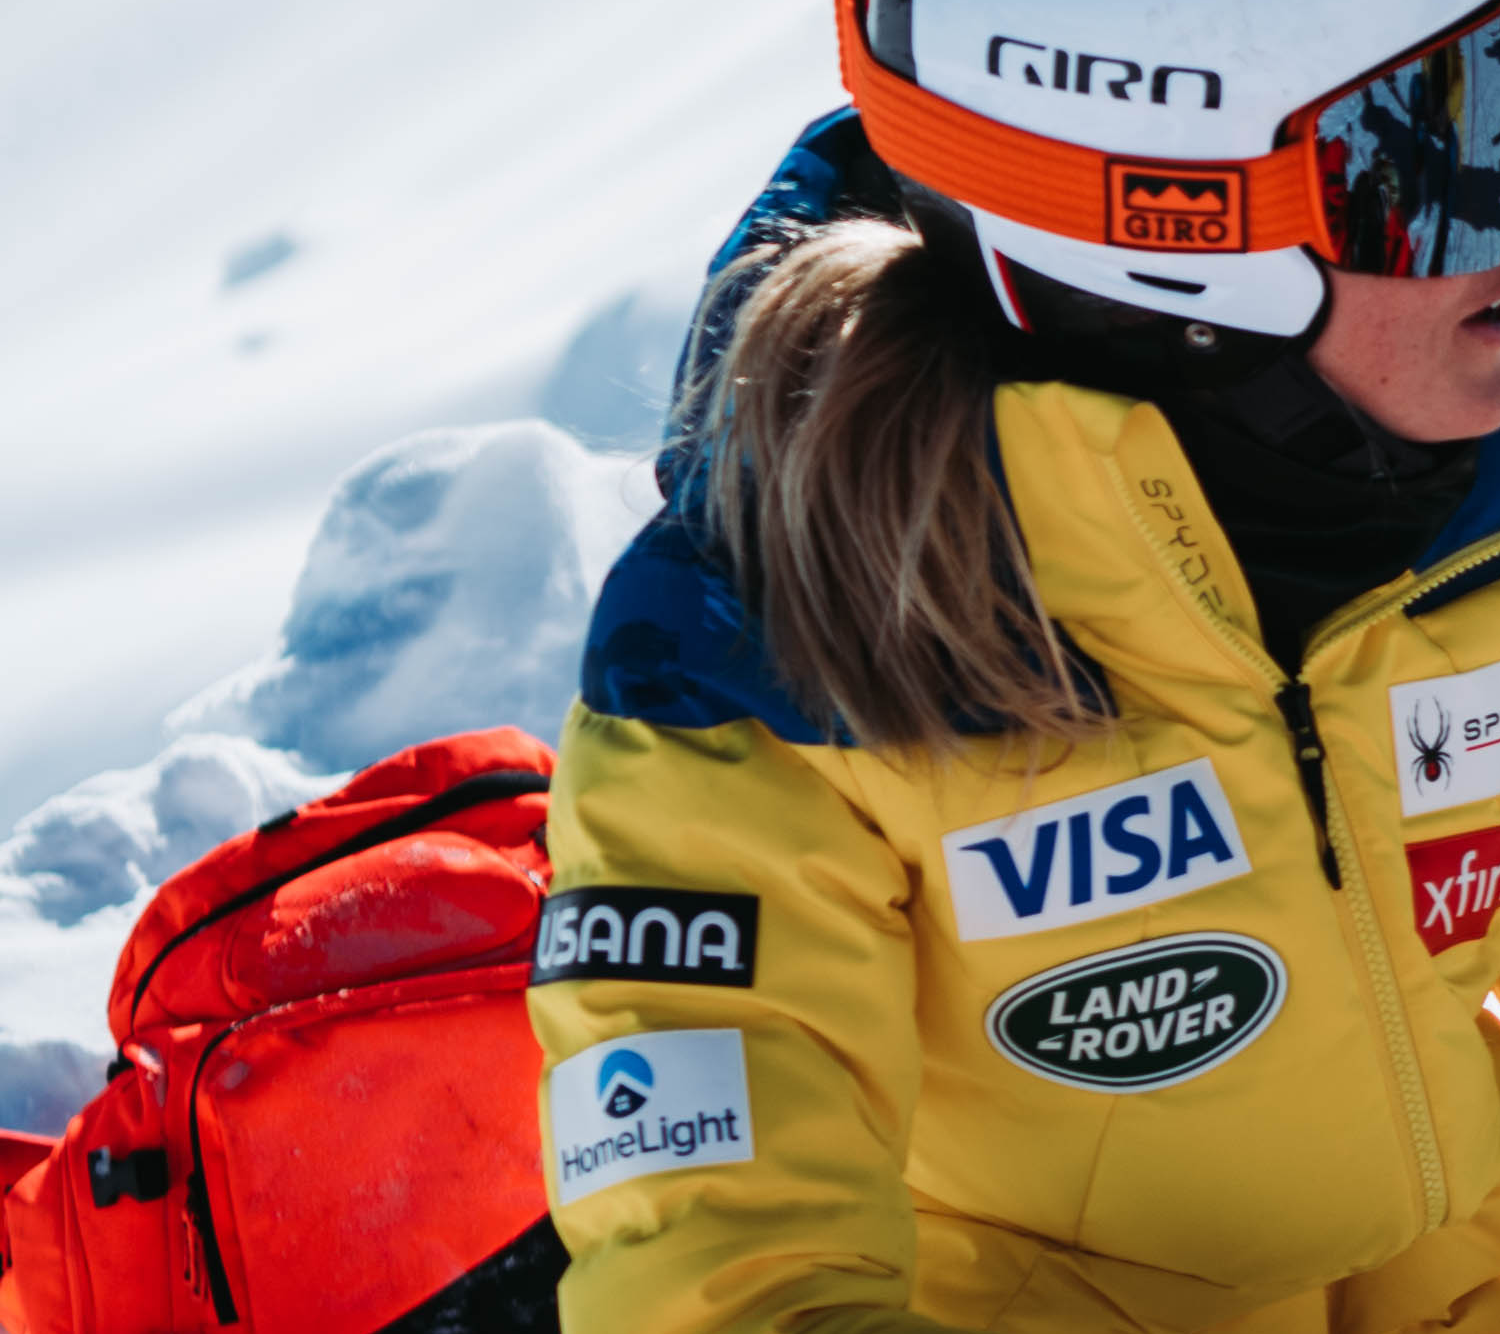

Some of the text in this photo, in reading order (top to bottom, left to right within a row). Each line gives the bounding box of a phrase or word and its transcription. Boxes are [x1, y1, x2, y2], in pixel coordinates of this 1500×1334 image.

[985, 34, 1223, 111] GIRO
[1123, 214, 1228, 247] GIRO
[1141, 478, 1232, 624] SPYDE
[958, 779, 1233, 918] VISA
[537, 905, 743, 970] USANA
[1050, 967, 1188, 1025] LAND
[1069, 994, 1234, 1062] ROVER
[560, 1107, 740, 1182] HomeLight
